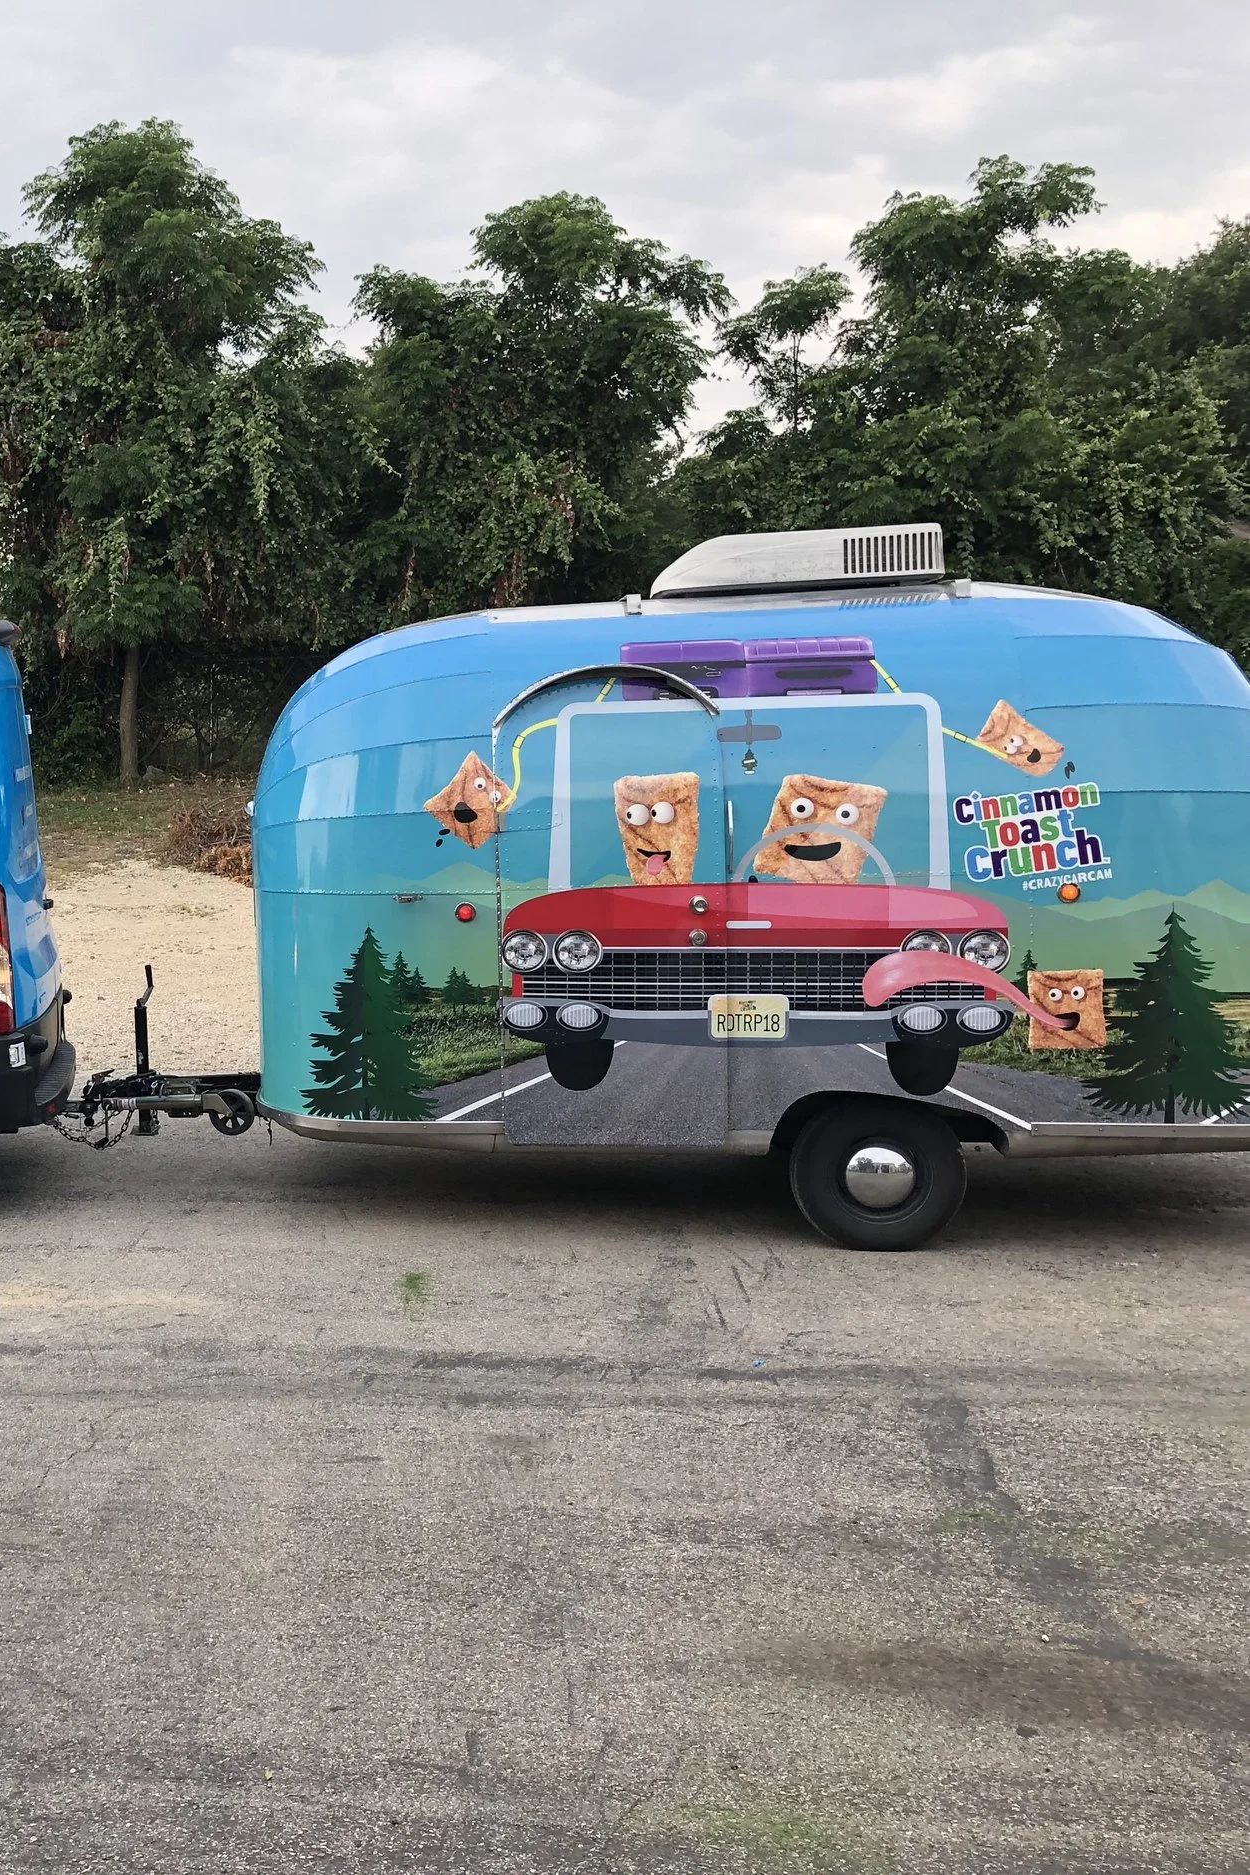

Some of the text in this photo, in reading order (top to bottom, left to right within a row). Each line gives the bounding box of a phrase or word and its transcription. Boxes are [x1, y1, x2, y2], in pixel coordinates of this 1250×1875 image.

[954, 782, 1099, 823] Cinnamon
[981, 809, 1075, 849] Toast
[966, 829, 1102, 880] Crunch
[1022, 868, 1113, 891] #CRAZYCARCAM
[717, 1013, 781, 1033] RDTRP18
